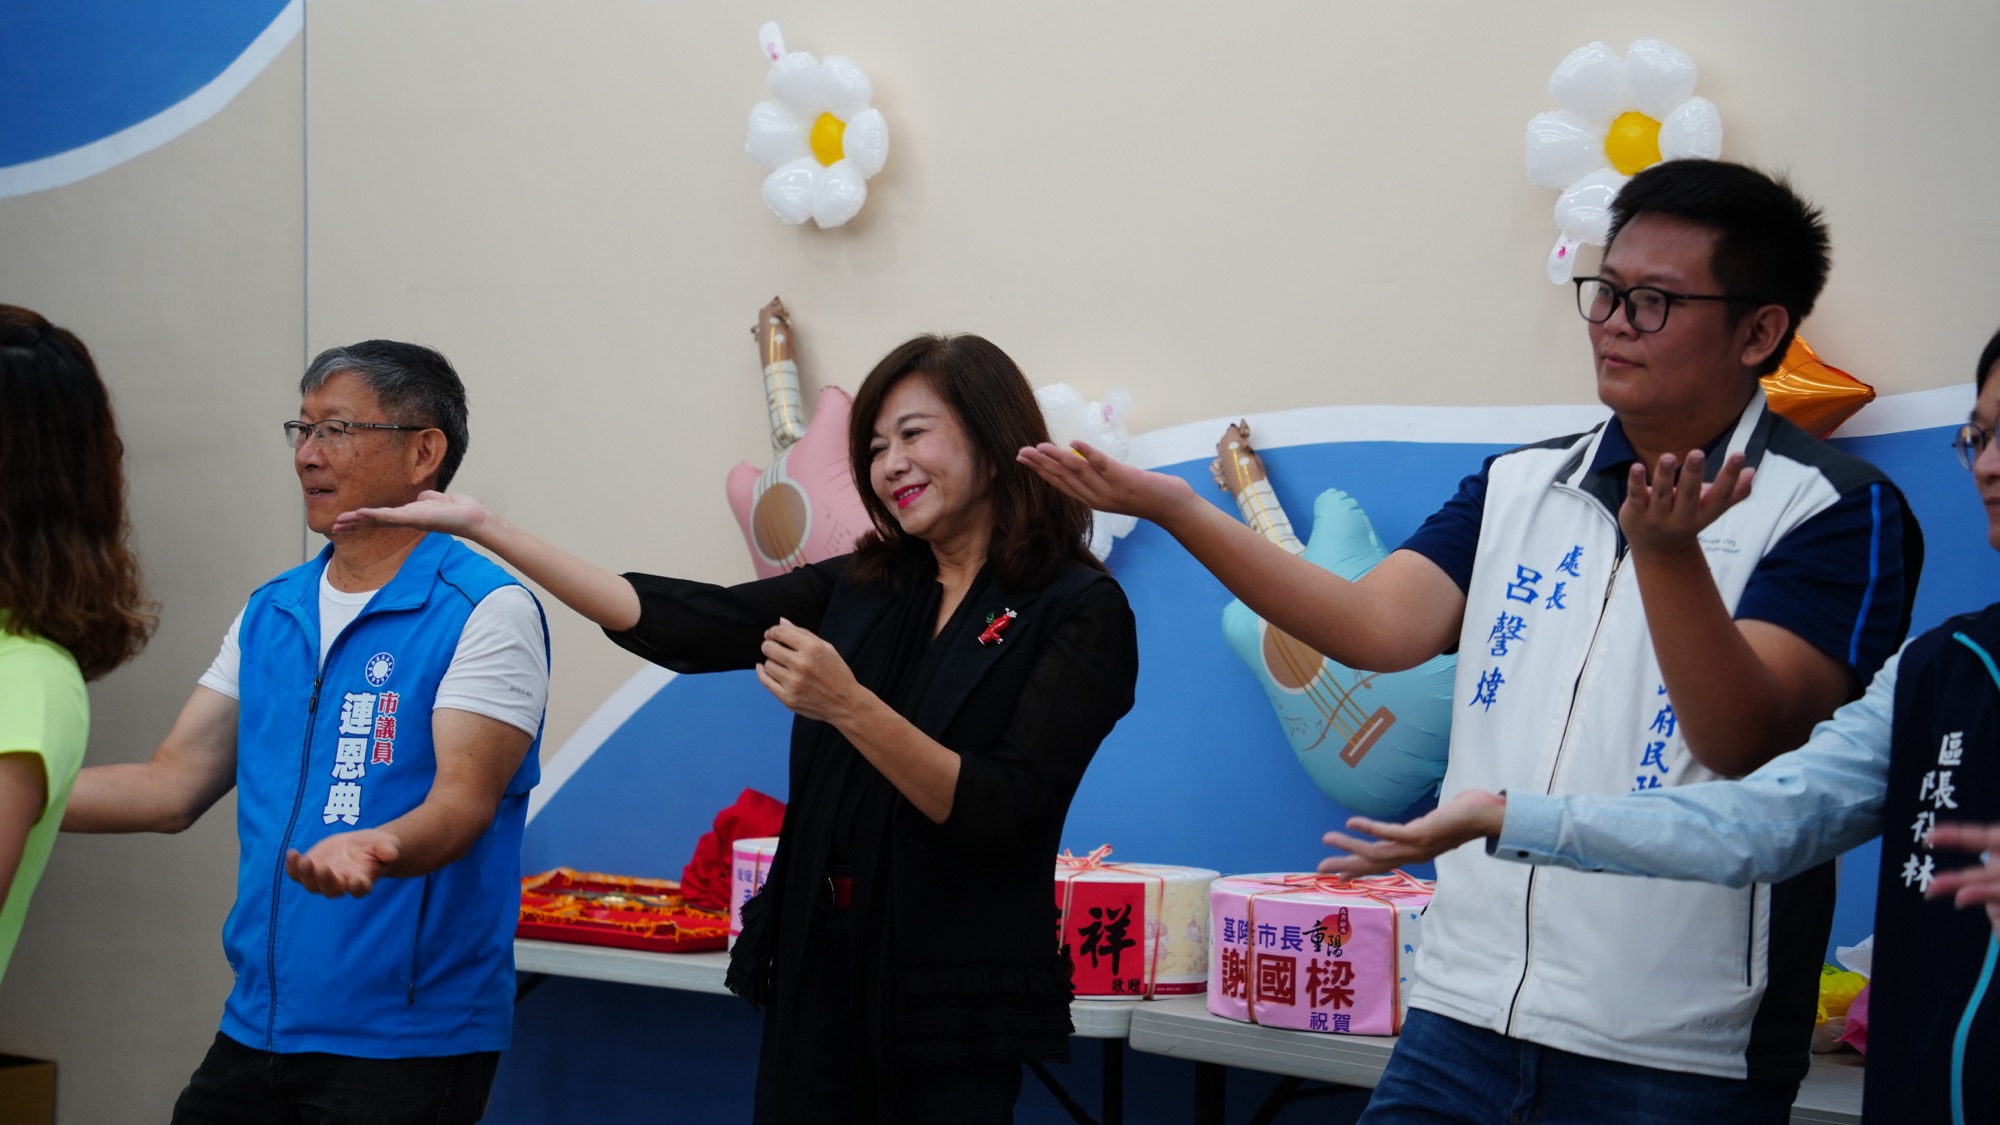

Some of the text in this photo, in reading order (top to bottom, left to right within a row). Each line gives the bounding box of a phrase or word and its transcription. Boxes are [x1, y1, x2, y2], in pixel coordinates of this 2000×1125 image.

[1545, 544, 1584, 611] 處長
[1468, 563, 1544, 713] 呂謦煒
[322, 691, 377, 827] 連恩典
[371, 690, 400, 766] 市議員
[1223, 916, 1304, 952] 基隆市長
[1302, 919, 1344, 958] 重陽
[1221, 947, 1356, 1010] 謝國樑
[1309, 1011, 1351, 1033] 祝賀
